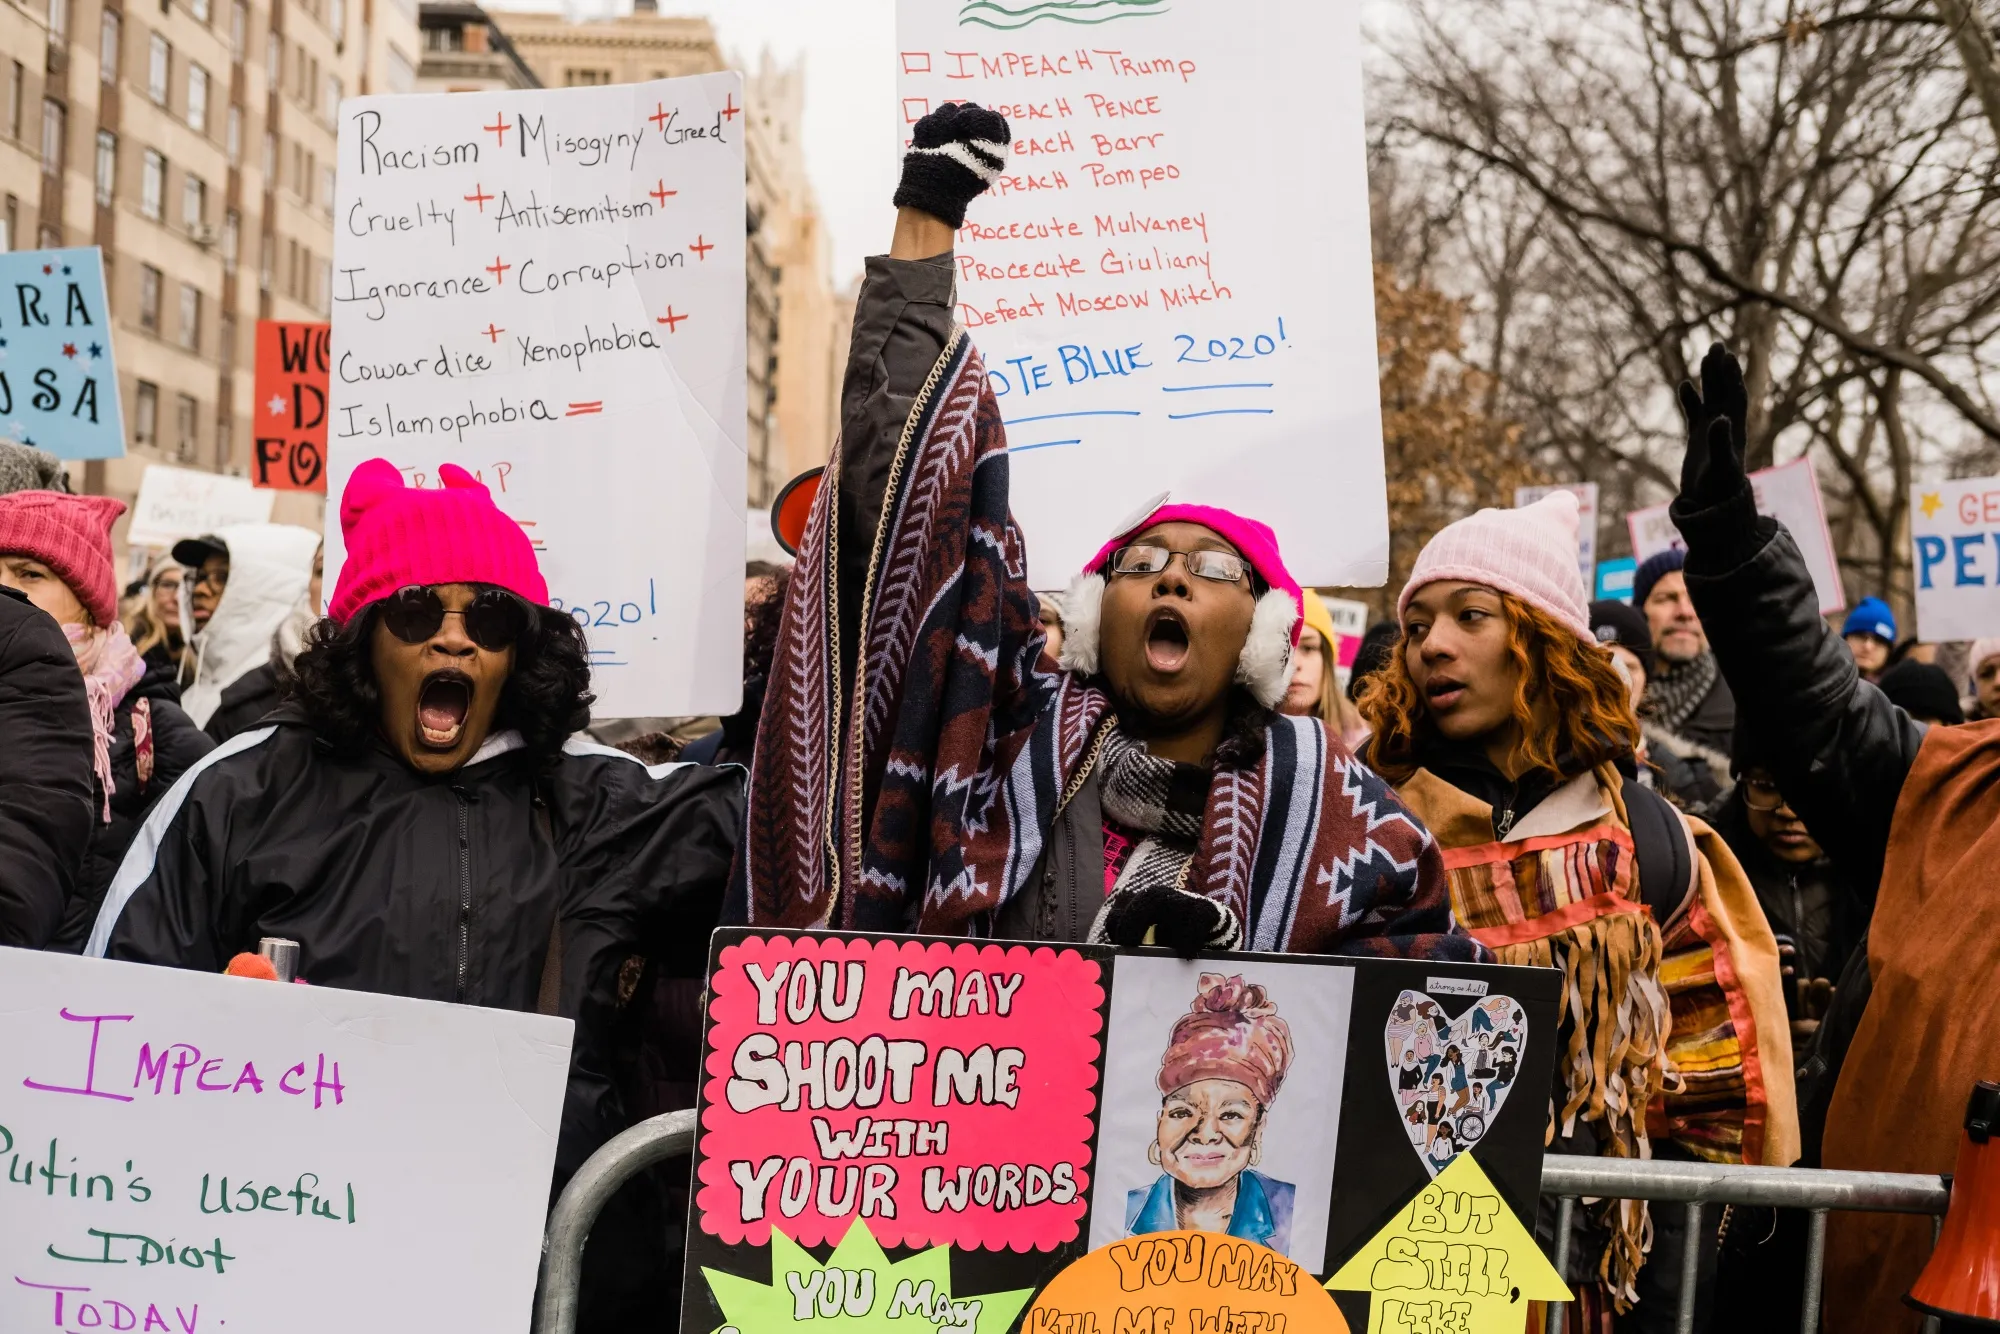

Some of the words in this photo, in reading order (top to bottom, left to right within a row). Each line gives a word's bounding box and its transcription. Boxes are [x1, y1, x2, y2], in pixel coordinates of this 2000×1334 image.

[945, 49, 1093, 80] IMPEACH
[944, 97, 1073, 119] PEACH
[1085, 94, 1162, 121] PENCE
[353, 110, 479, 175] Racism
[518, 113, 644, 171] Misogyny
[663, 107, 727, 145] Greed
[1013, 129, 1075, 157] EACH
[1090, 132, 1165, 158] Barr
[983, 170, 1069, 197] PEACH
[1080, 162, 1181, 191] Pompeo
[349, 197, 455, 246] Cruelty
[494, 190, 653, 232] Antisemitism
[1095, 211, 1208, 245] Mulvaney
[334, 268, 491, 320] Ignorance
[519, 244, 684, 294] Corruption
[1100, 247, 1211, 280] Giuliany
[0, 281, 93, 328] RA
[957, 292, 1045, 328] Defeat
[1056, 289, 1149, 317] Moscow
[1160, 281, 1233, 312] Mitch
[339, 344, 492, 383] Cowardice
[517, 323, 661, 372] Xenophobia
[982, 353, 1053, 397] OTE
[1057, 342, 1153, 385] BLUE
[1174, 316, 1293, 364] 2020!
[338, 397, 558, 442] Islamophobia
[745, 959, 866, 1026] YOU
[889, 966, 1025, 1020] MAY
[1429, 980, 1455, 994] strong
[1465, 982, 1486, 994] hell
[23, 1007, 346, 1110] IMPEACH
[725, 1033, 927, 1114] SHOOT
[933, 1044, 1026, 1109] ME
[811, 1116, 948, 1160] WITH
[200, 1172, 356, 1225] Useful
[729, 1156, 899, 1224] YOUR
[1407, 1183, 1501, 1235] BUT
[1109, 1235, 1205, 1292] YOU
[1207, 1243, 1299, 1297] MAY
[1370, 1236, 1521, 1304] STILL,
[785, 1267, 877, 1321] YOU
[1379, 1299, 1473, 1334] LIKE
